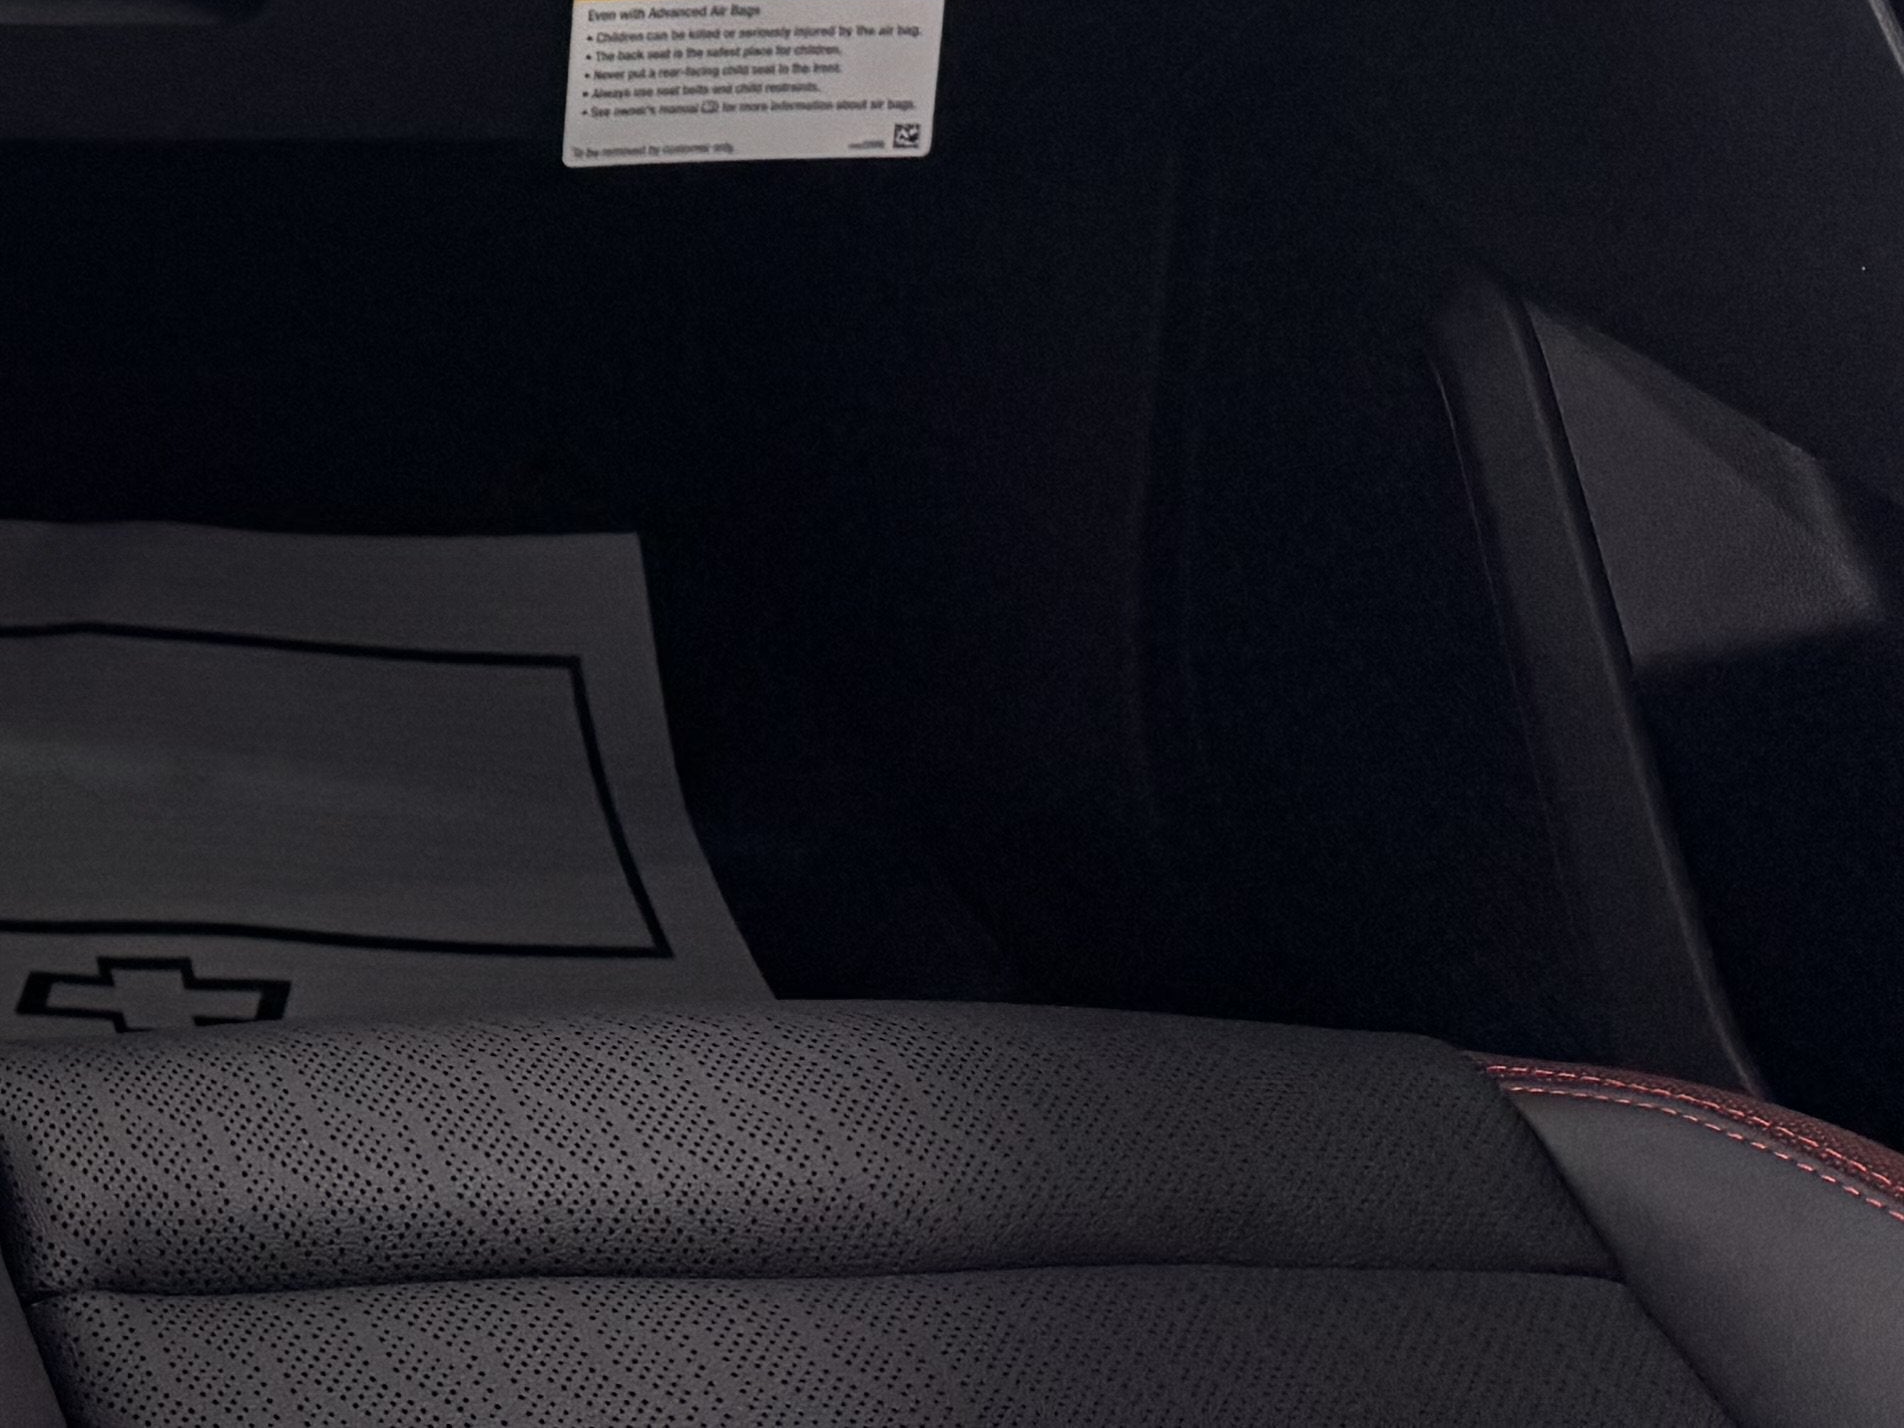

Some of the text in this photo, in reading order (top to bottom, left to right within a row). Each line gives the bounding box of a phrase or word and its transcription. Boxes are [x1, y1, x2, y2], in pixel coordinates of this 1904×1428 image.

[588, 4, 760, 22] Even with Advanced Air Bags
